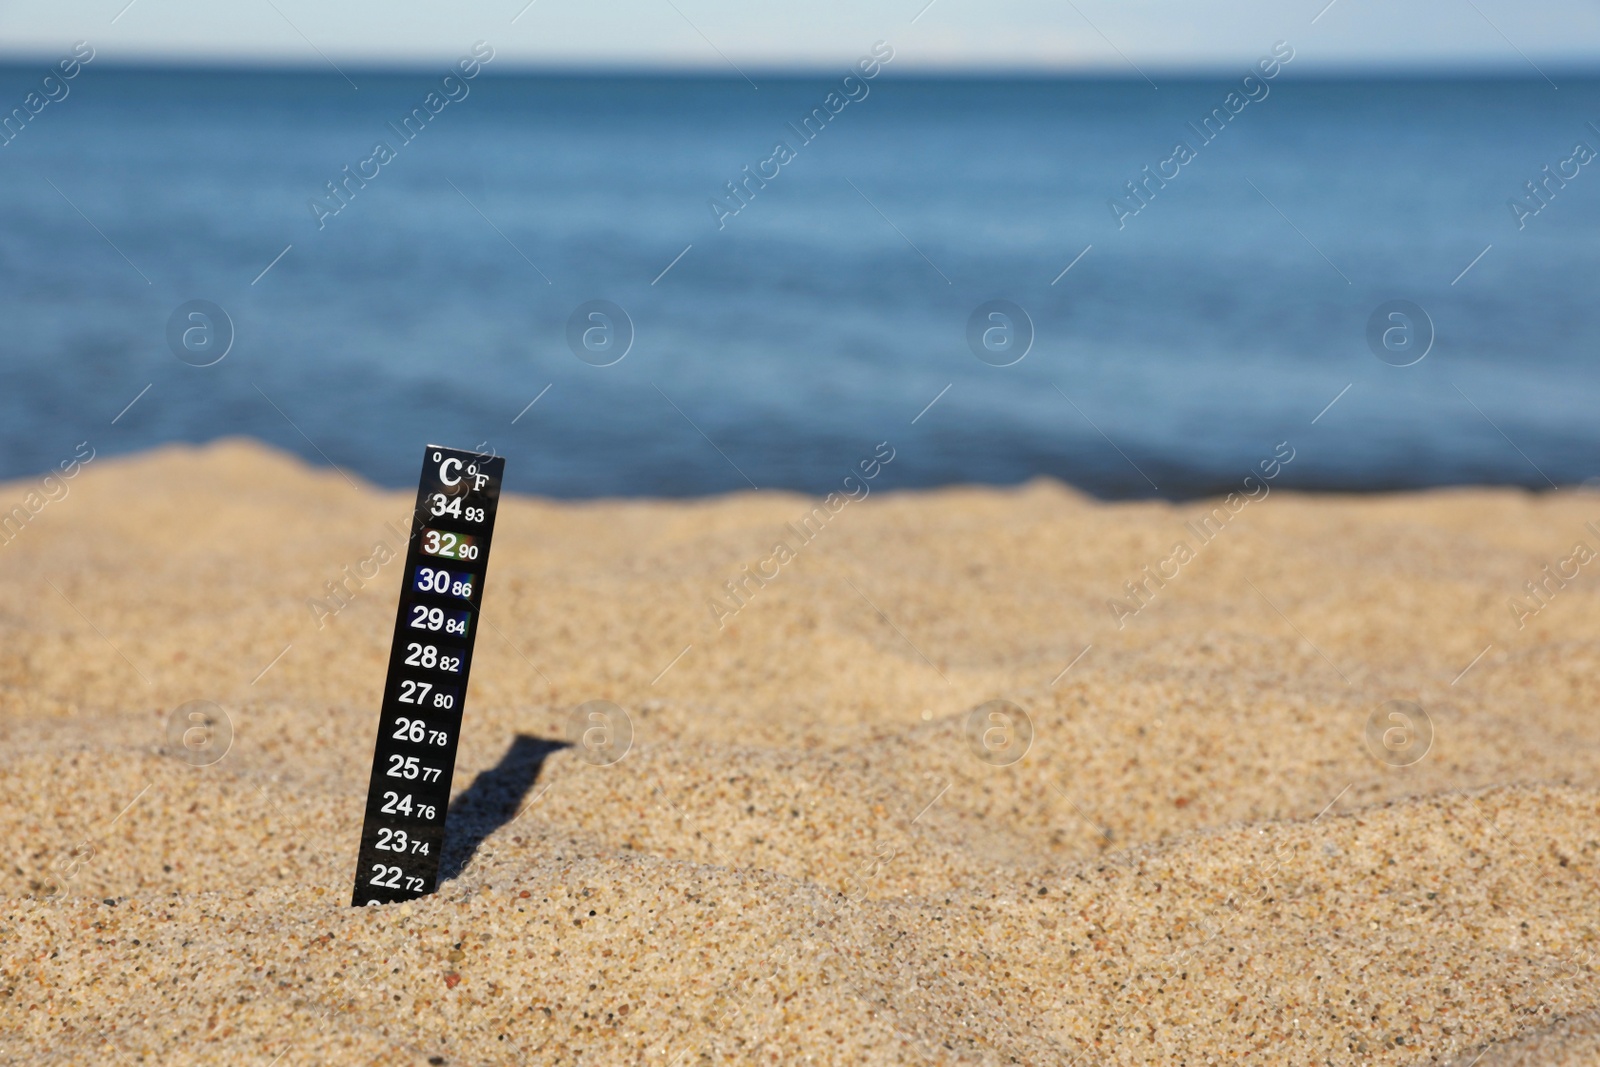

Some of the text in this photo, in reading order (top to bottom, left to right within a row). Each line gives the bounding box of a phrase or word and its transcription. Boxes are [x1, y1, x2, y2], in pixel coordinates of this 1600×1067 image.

[430, 493, 485, 523] 34 93
[424, 530, 479, 560] 32 90
[417, 567, 473, 598] 30 86
[410, 605, 466, 635] 29 84
[404, 642, 460, 673] 28 82
[398, 679, 454, 710] 27 80
[392, 717, 448, 747] 26 78
[386, 754, 442, 783] 25 77
[380, 791, 436, 820] 24 76
[374, 827, 430, 856] 23 74
[369, 863, 425, 892] 22 72
